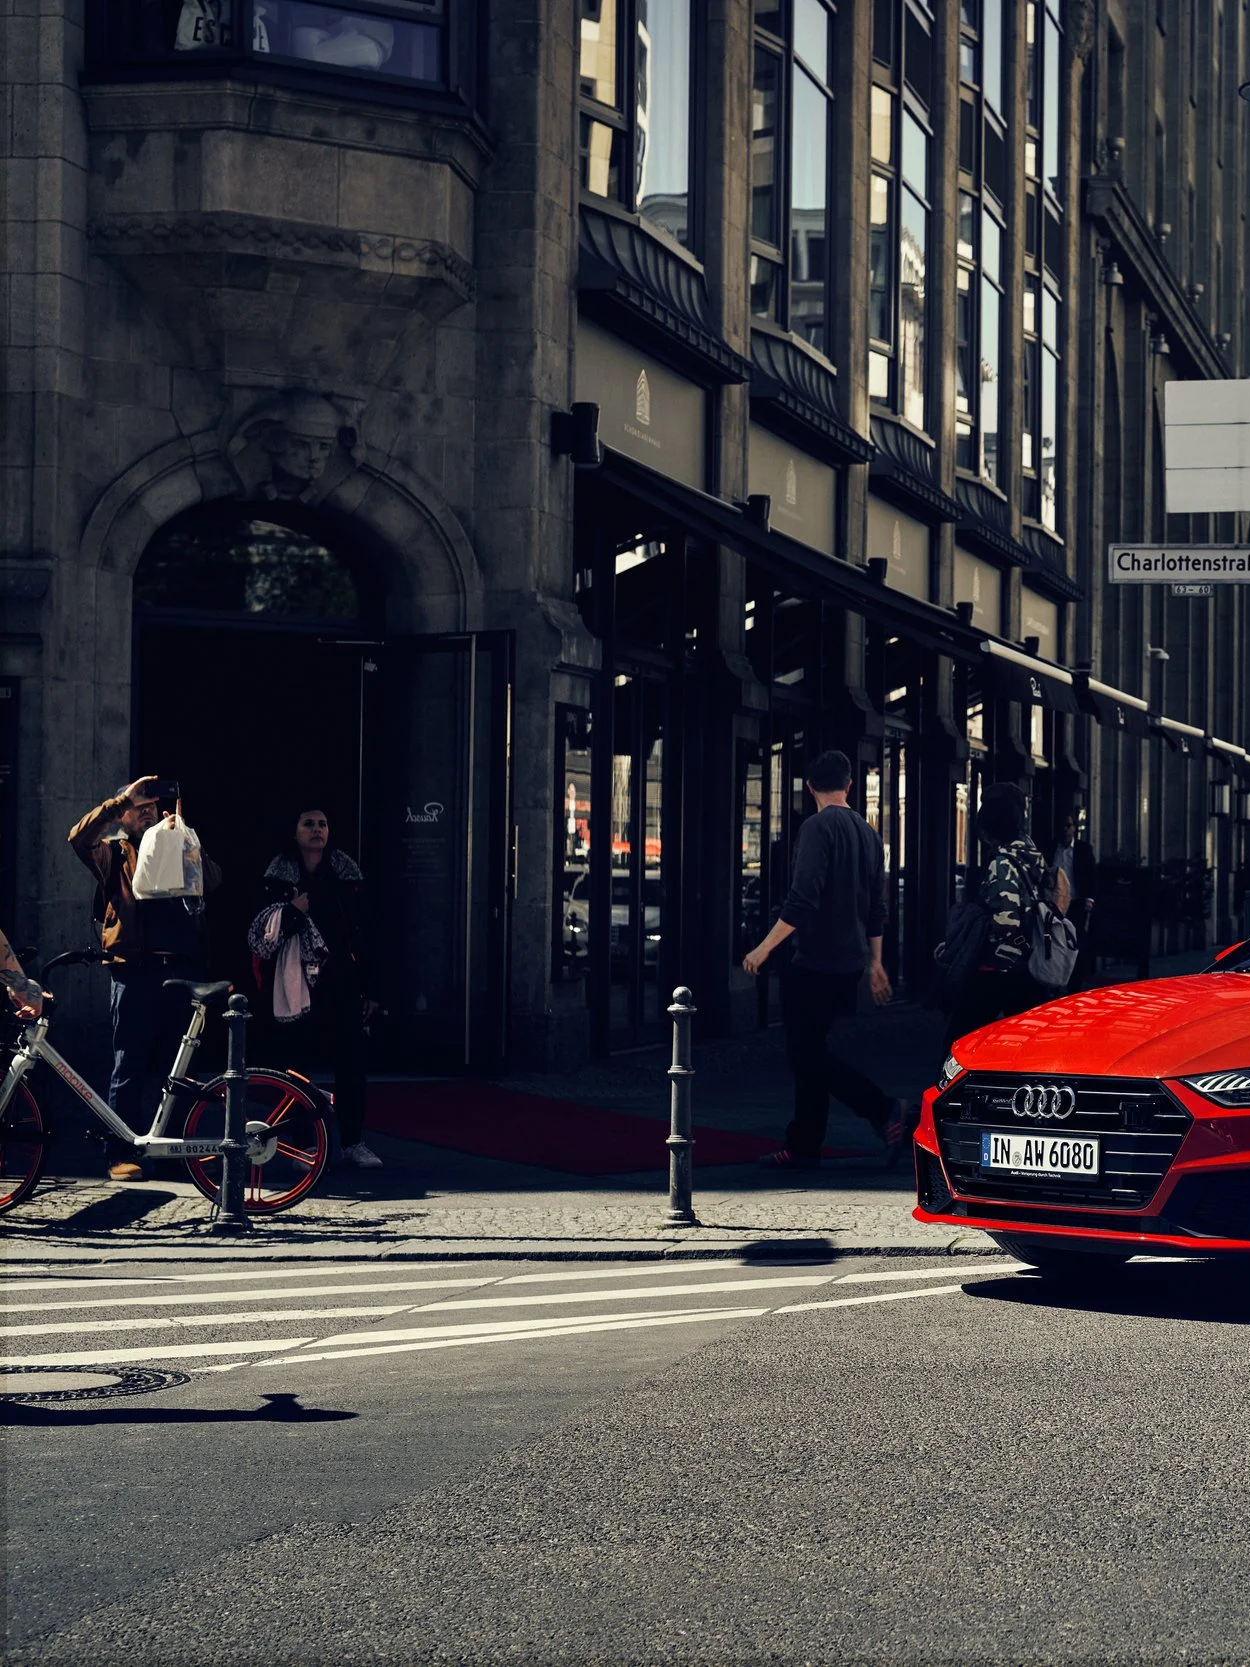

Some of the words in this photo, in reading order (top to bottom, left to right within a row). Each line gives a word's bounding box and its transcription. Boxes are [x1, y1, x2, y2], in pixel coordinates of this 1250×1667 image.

[56, 1062, 93, 1100] mobike
[983, 1153, 989, 1161] D
[992, 1137, 1011, 1165] IN
[1023, 1139, 1045, 1167] AW
[1049, 1141, 1094, 1170] 6080
